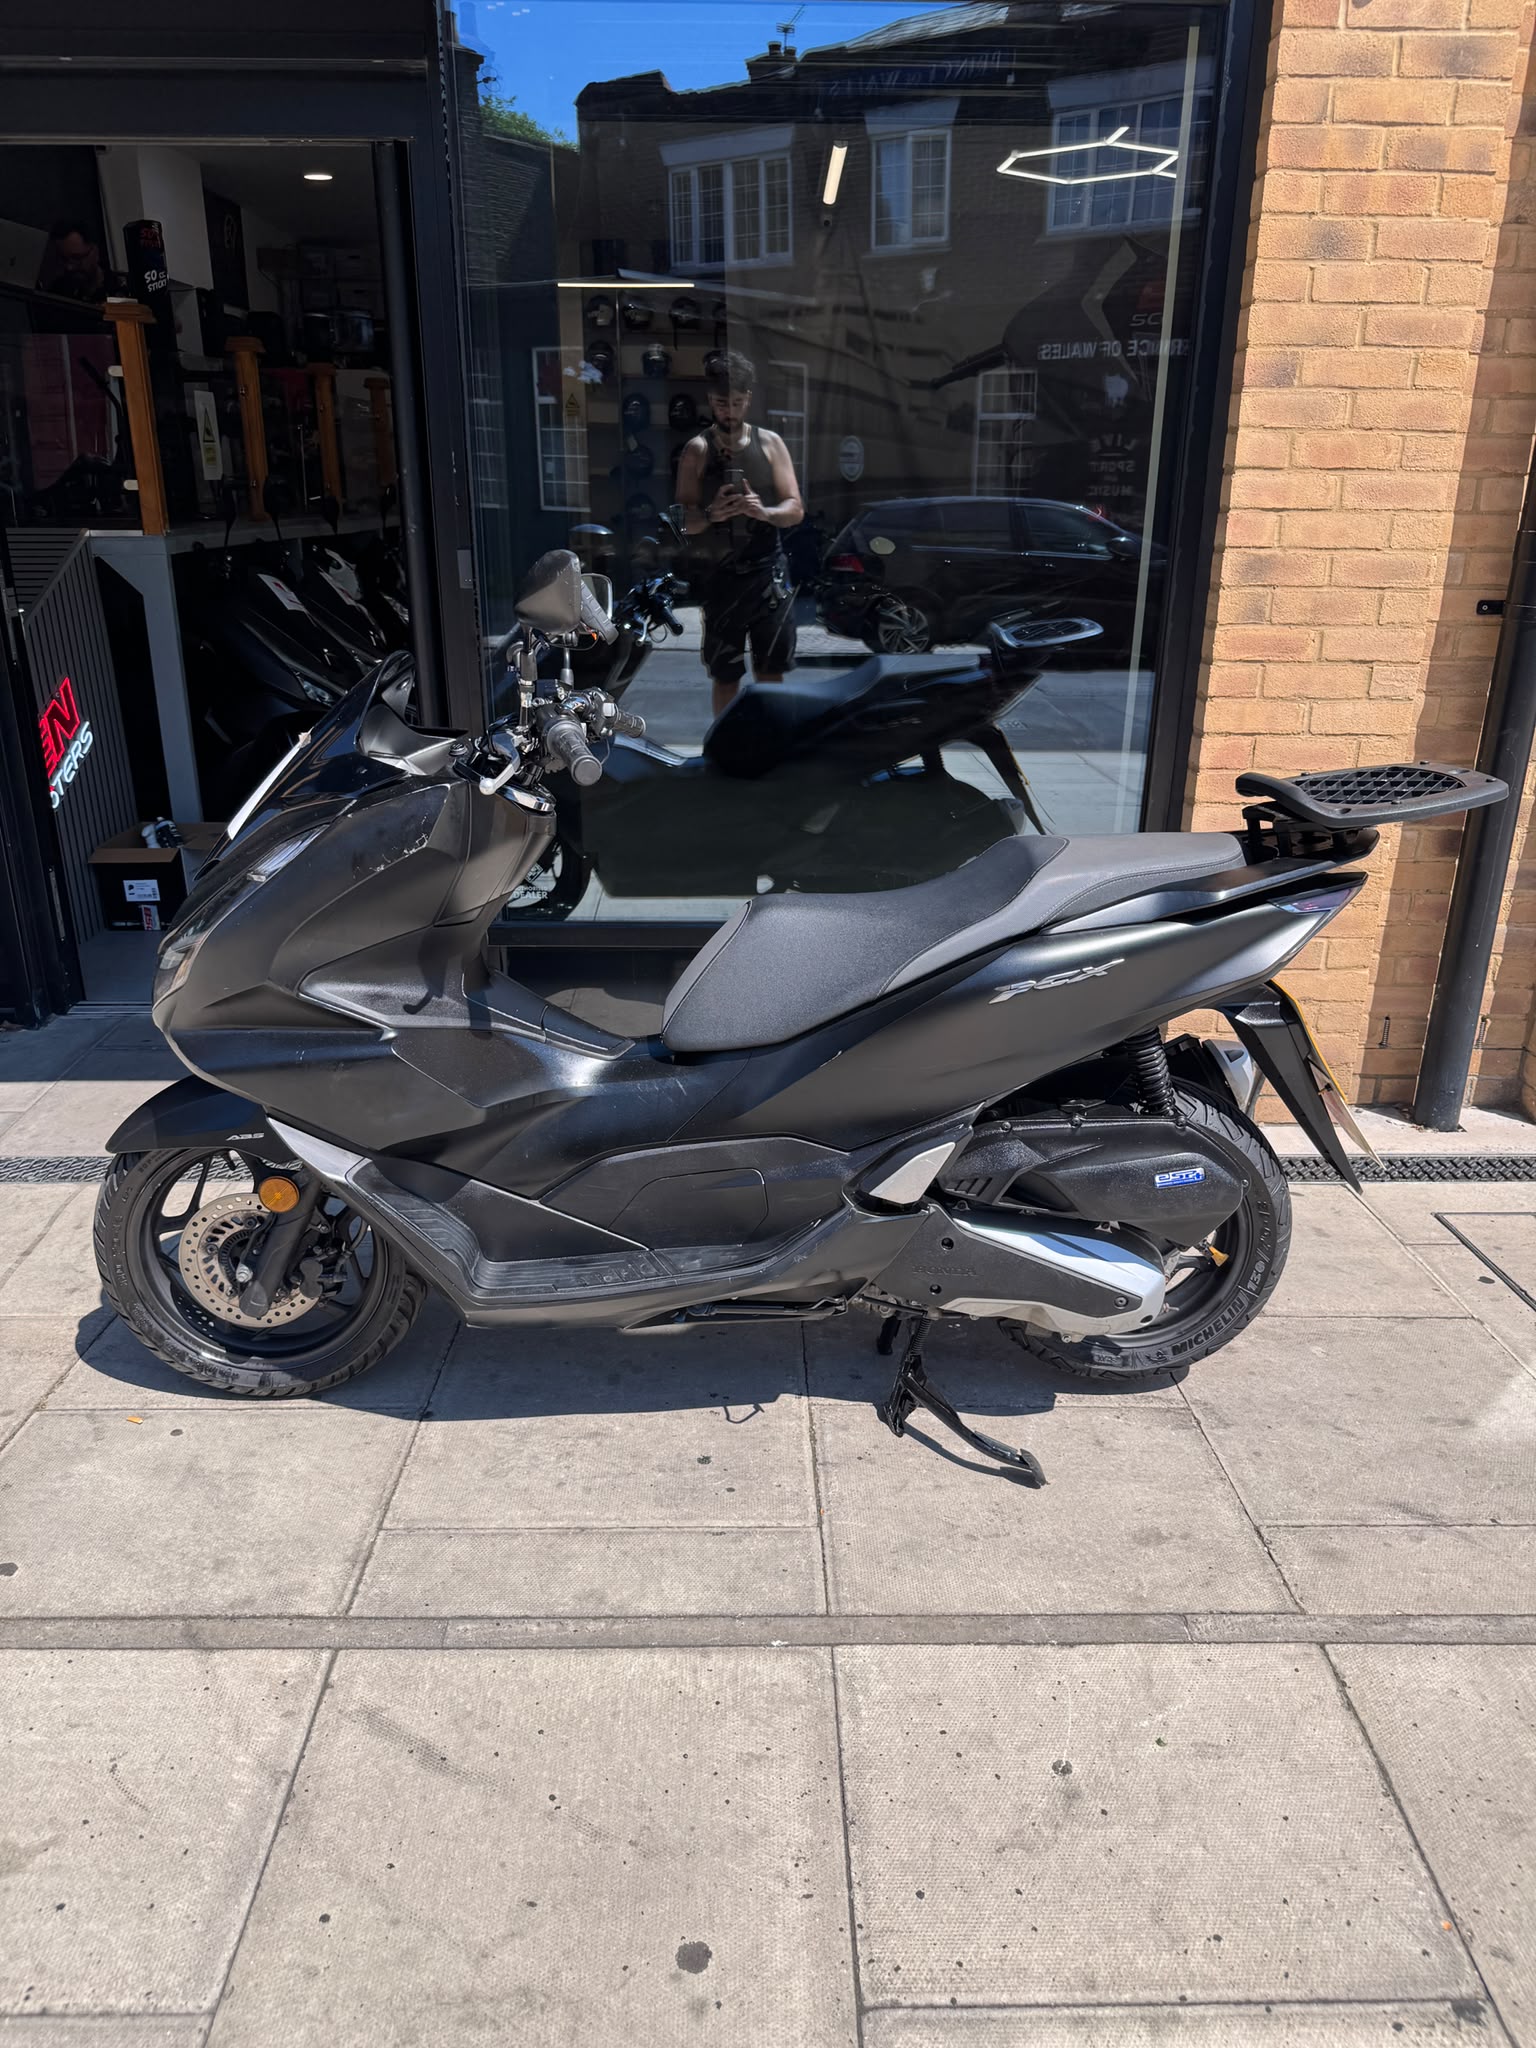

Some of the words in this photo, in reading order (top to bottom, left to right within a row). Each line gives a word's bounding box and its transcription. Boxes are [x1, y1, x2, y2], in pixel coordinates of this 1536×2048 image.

[988, 957, 1125, 1005] PCX
[225, 1132, 265, 1141] ABS
[1171, 1295, 1246, 1357] MICHELIN
